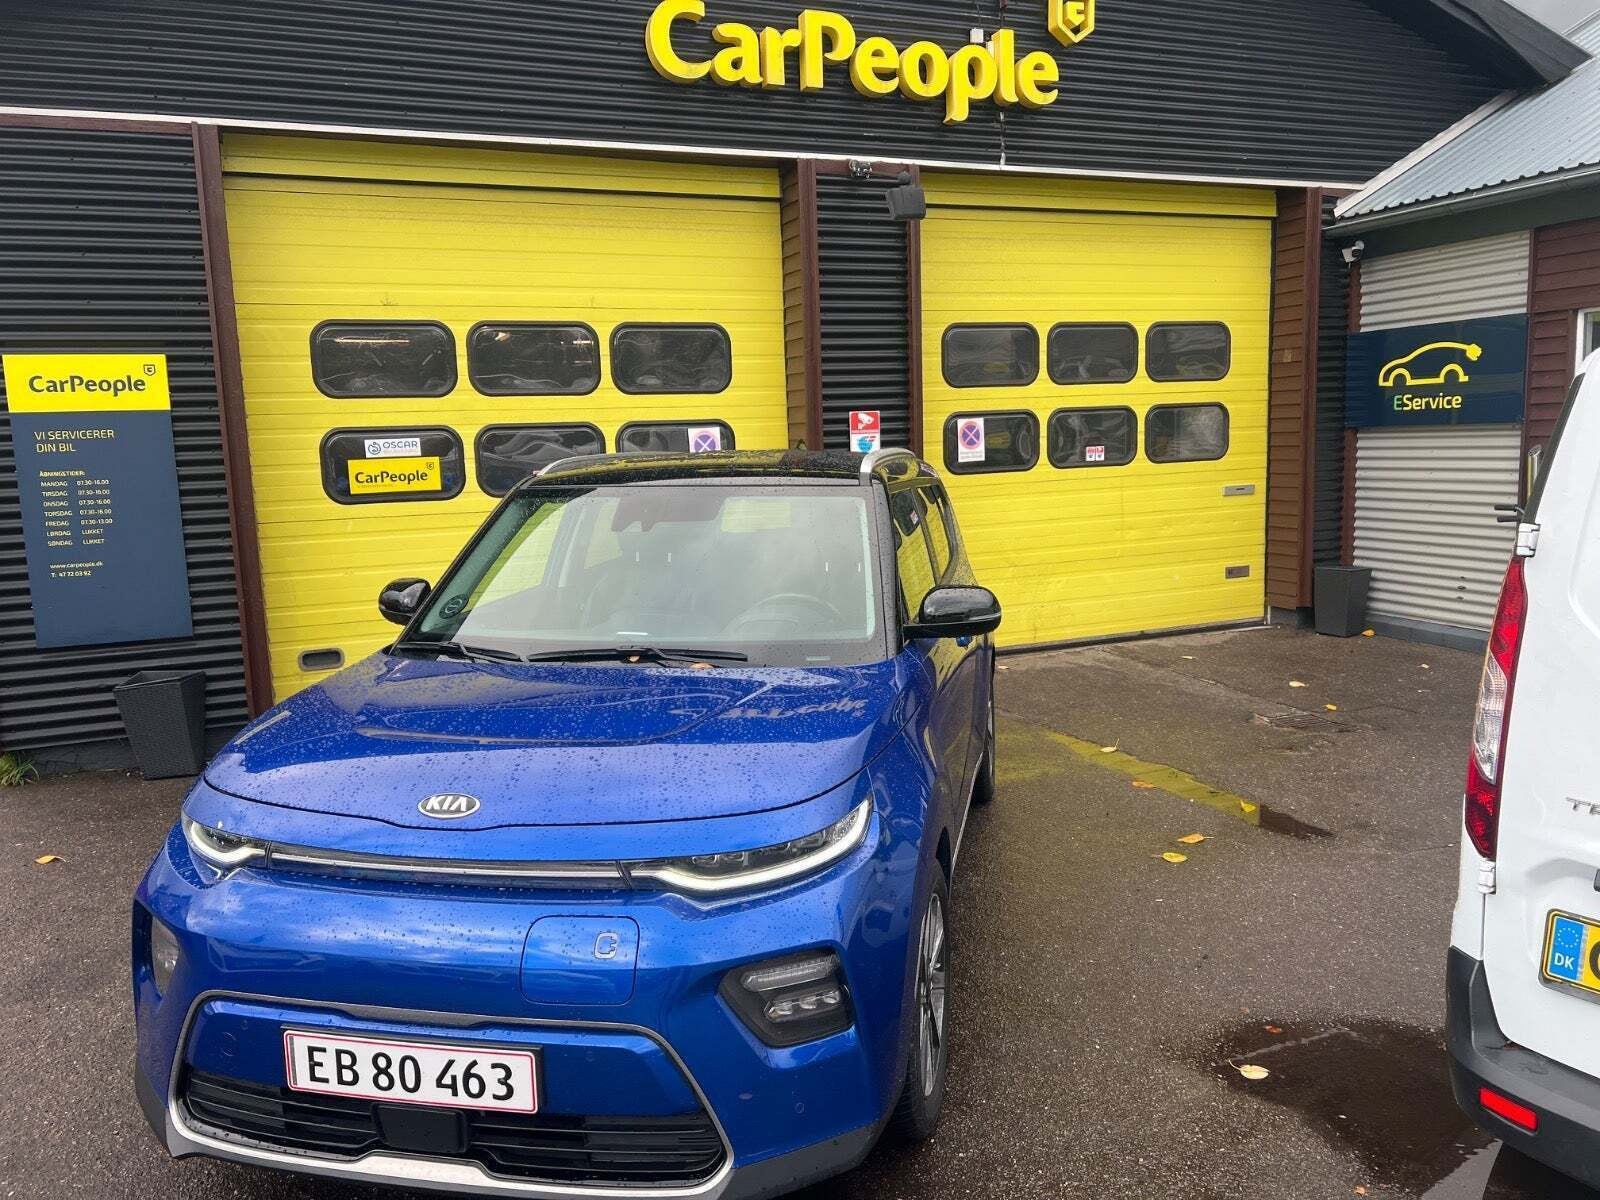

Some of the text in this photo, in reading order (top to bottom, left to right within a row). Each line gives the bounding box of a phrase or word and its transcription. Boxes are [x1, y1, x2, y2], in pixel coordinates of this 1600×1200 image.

[644, 0, 1060, 124] CarPeople
[28, 375, 146, 397] CarPeople
[1393, 392, 1463, 411] EService
[34, 429, 115, 441] VI SERVICERER
[36, 443, 77, 453] DIN BIL
[383, 440, 418, 449] OSCAR
[354, 470, 428, 484] CarPeople
[425, 795, 468, 812] KIA
[1553, 952, 1576, 971] DK
[306, 1044, 515, 1102] EB 80 463
